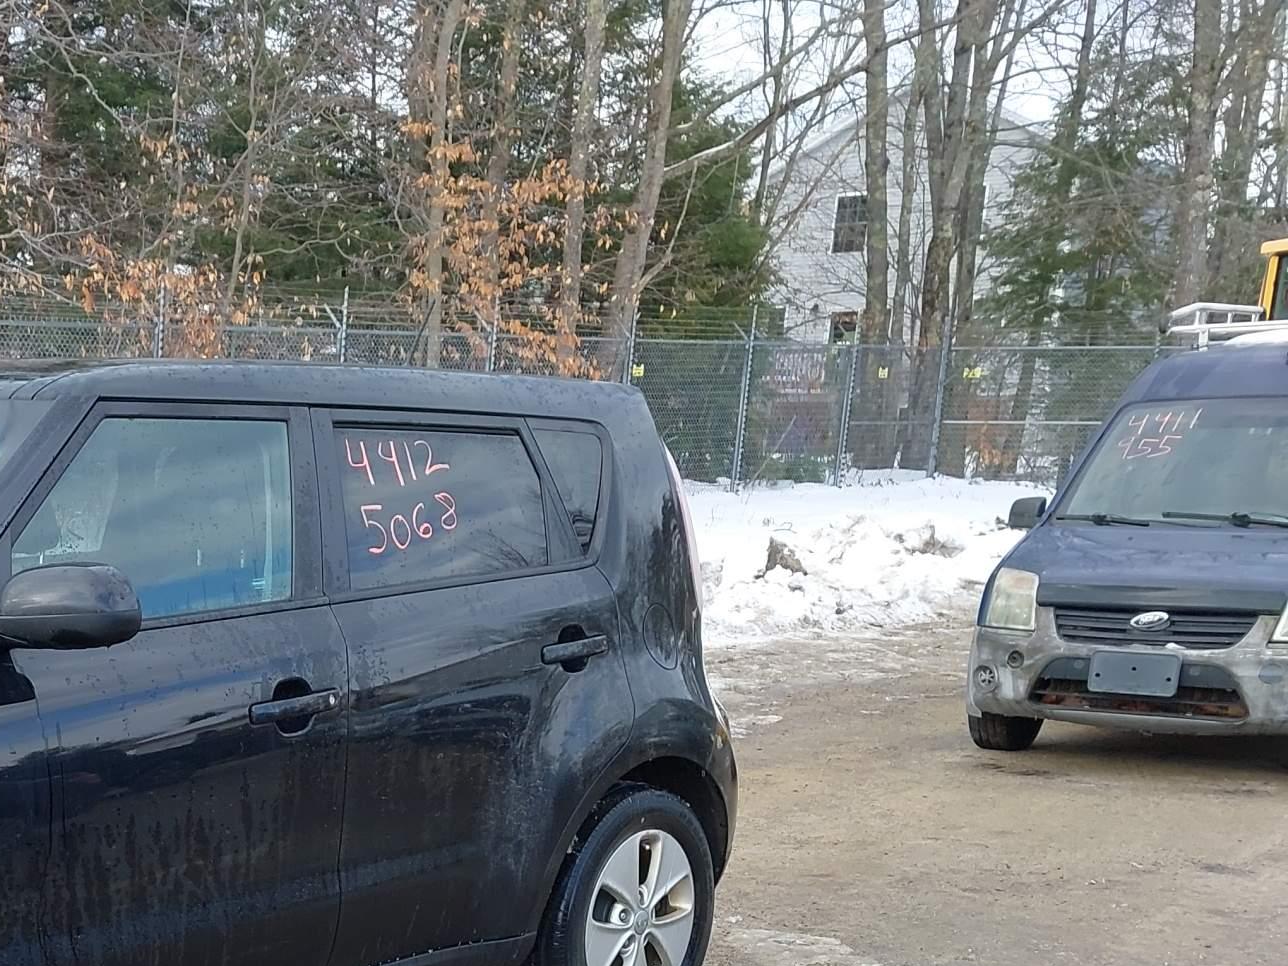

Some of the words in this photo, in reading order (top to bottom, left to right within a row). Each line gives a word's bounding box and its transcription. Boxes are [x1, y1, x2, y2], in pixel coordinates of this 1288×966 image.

[1128, 408, 1203, 435] 4411
[344, 438, 450, 486] 4412
[360, 491, 457, 554] 5068
